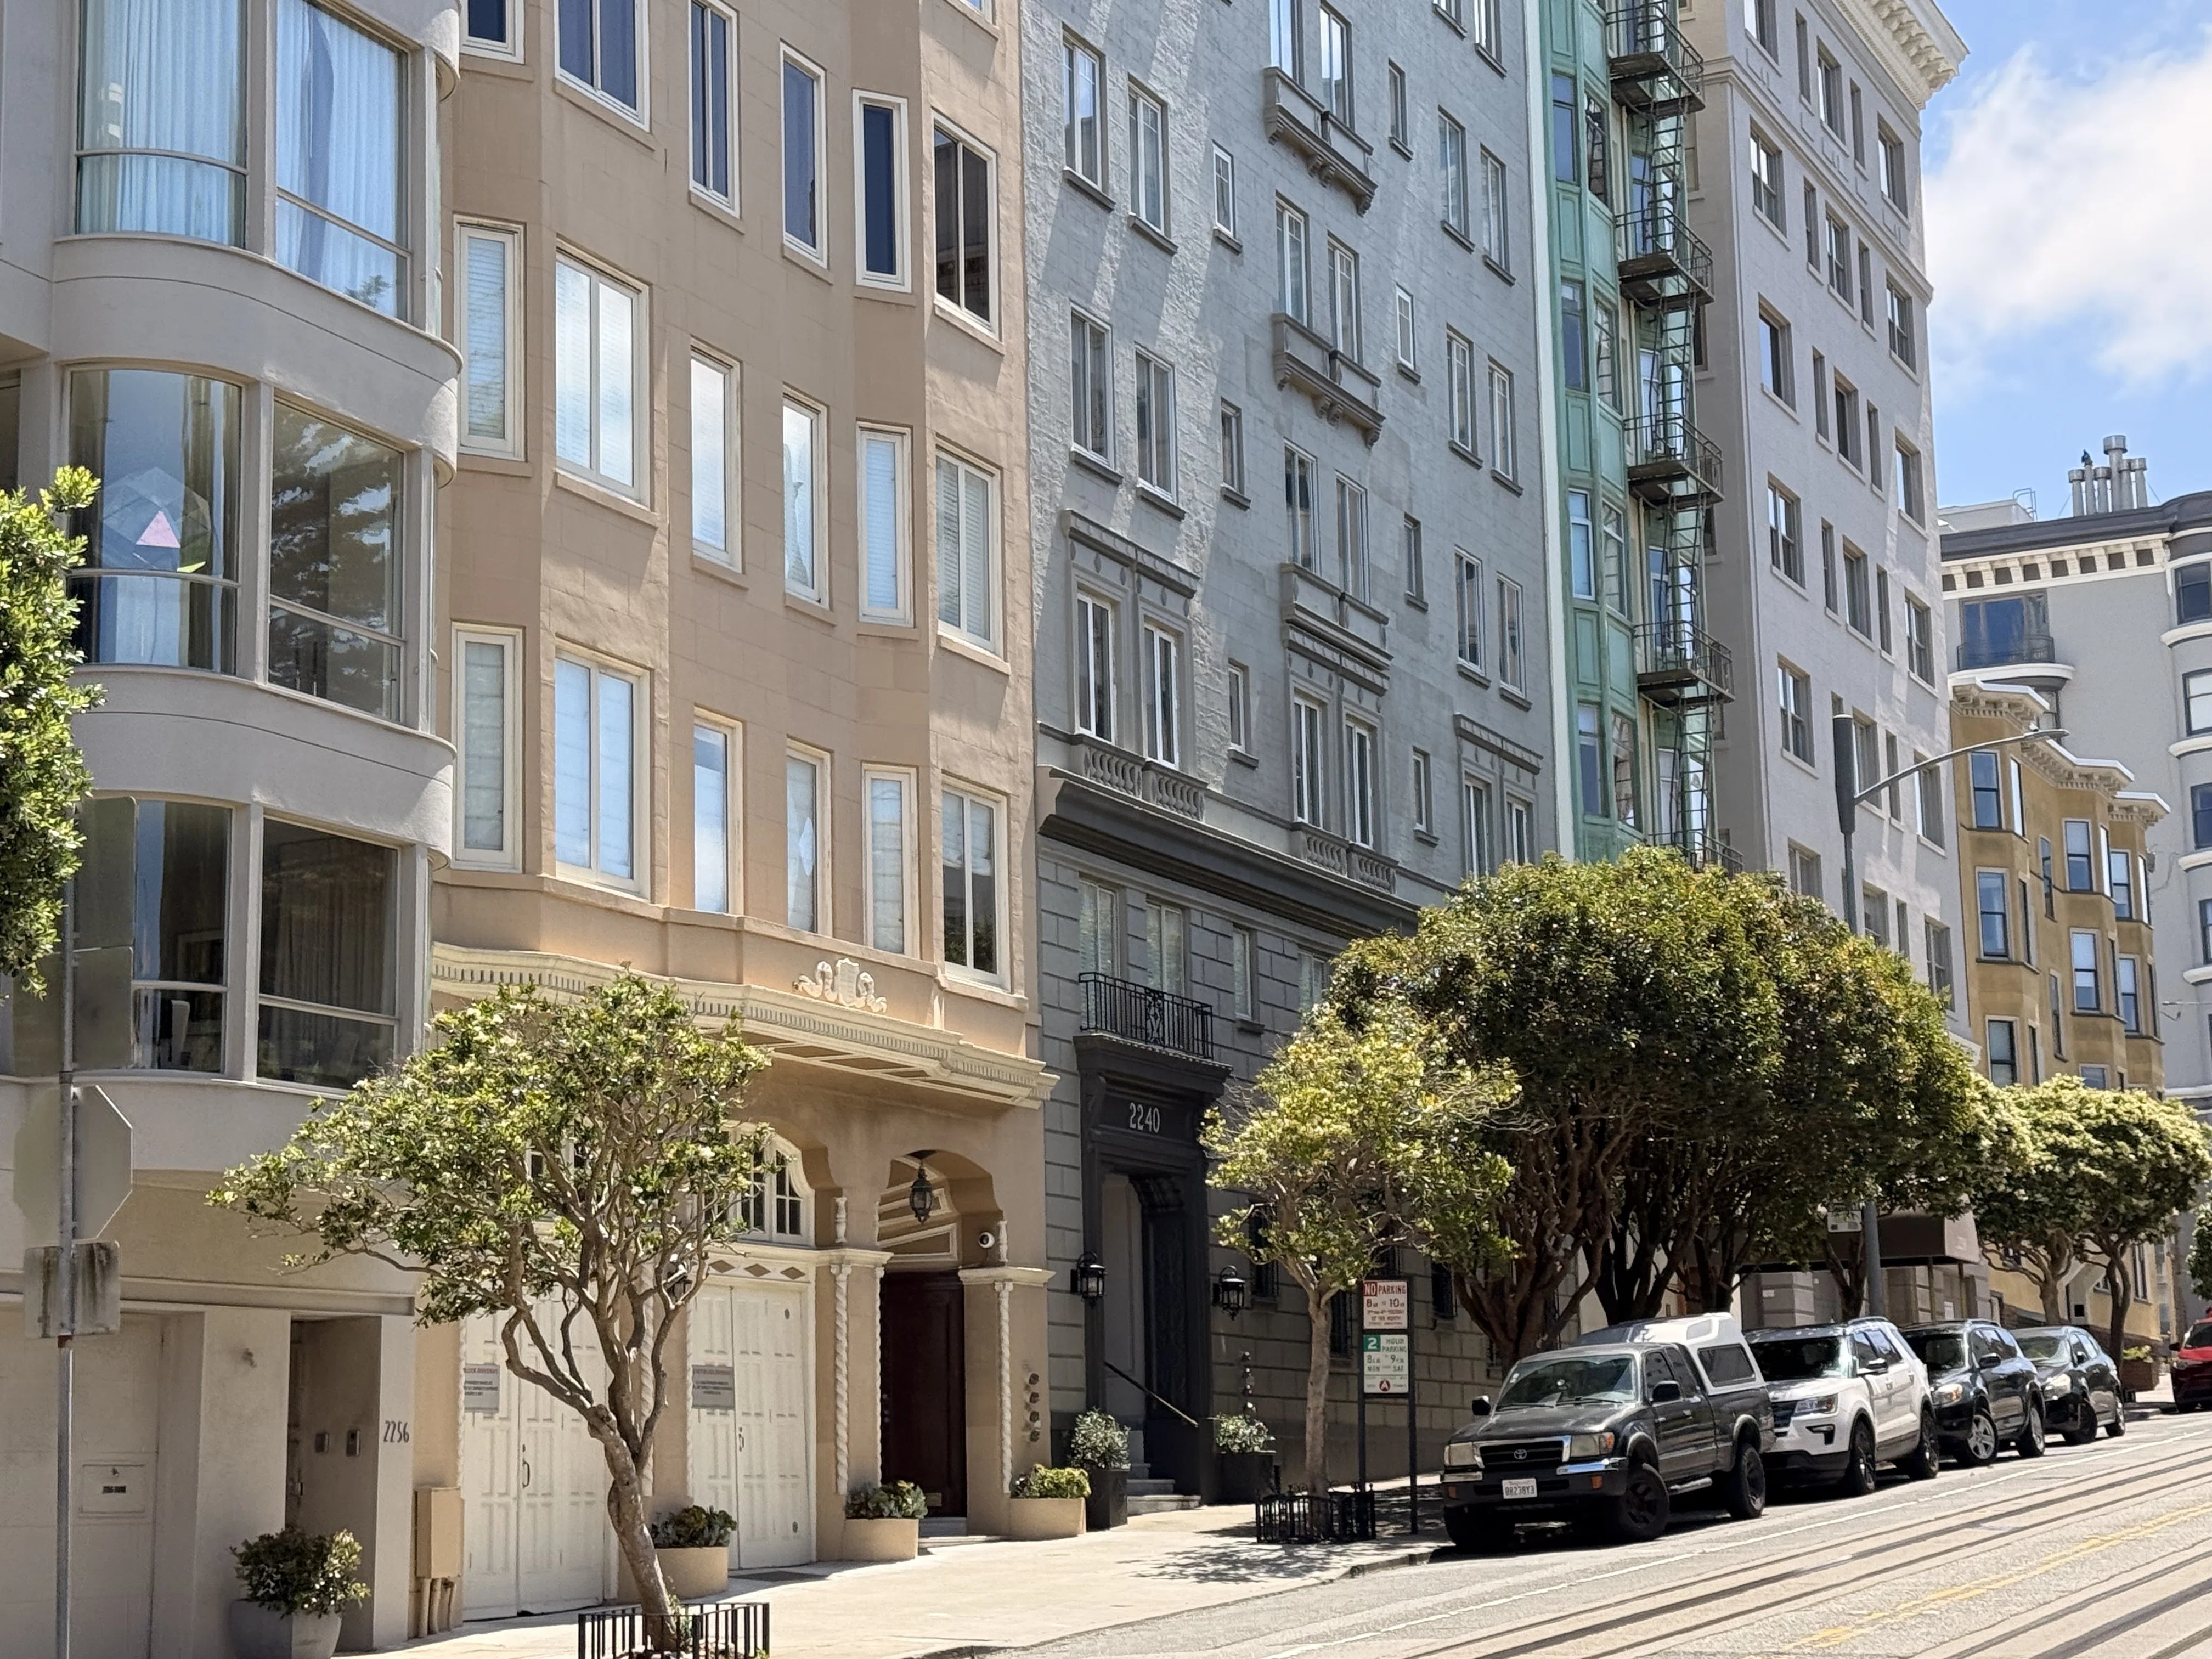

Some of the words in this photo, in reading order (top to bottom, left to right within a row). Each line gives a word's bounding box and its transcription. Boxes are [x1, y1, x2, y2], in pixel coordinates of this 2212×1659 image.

[1130, 1102, 1160, 1133] 2240
[1364, 1283, 1376, 1295] NO
[1378, 1285, 1406, 1295] PARKING
[1367, 1337, 1378, 1350] 2
[383, 1420, 410, 1443] 2256
